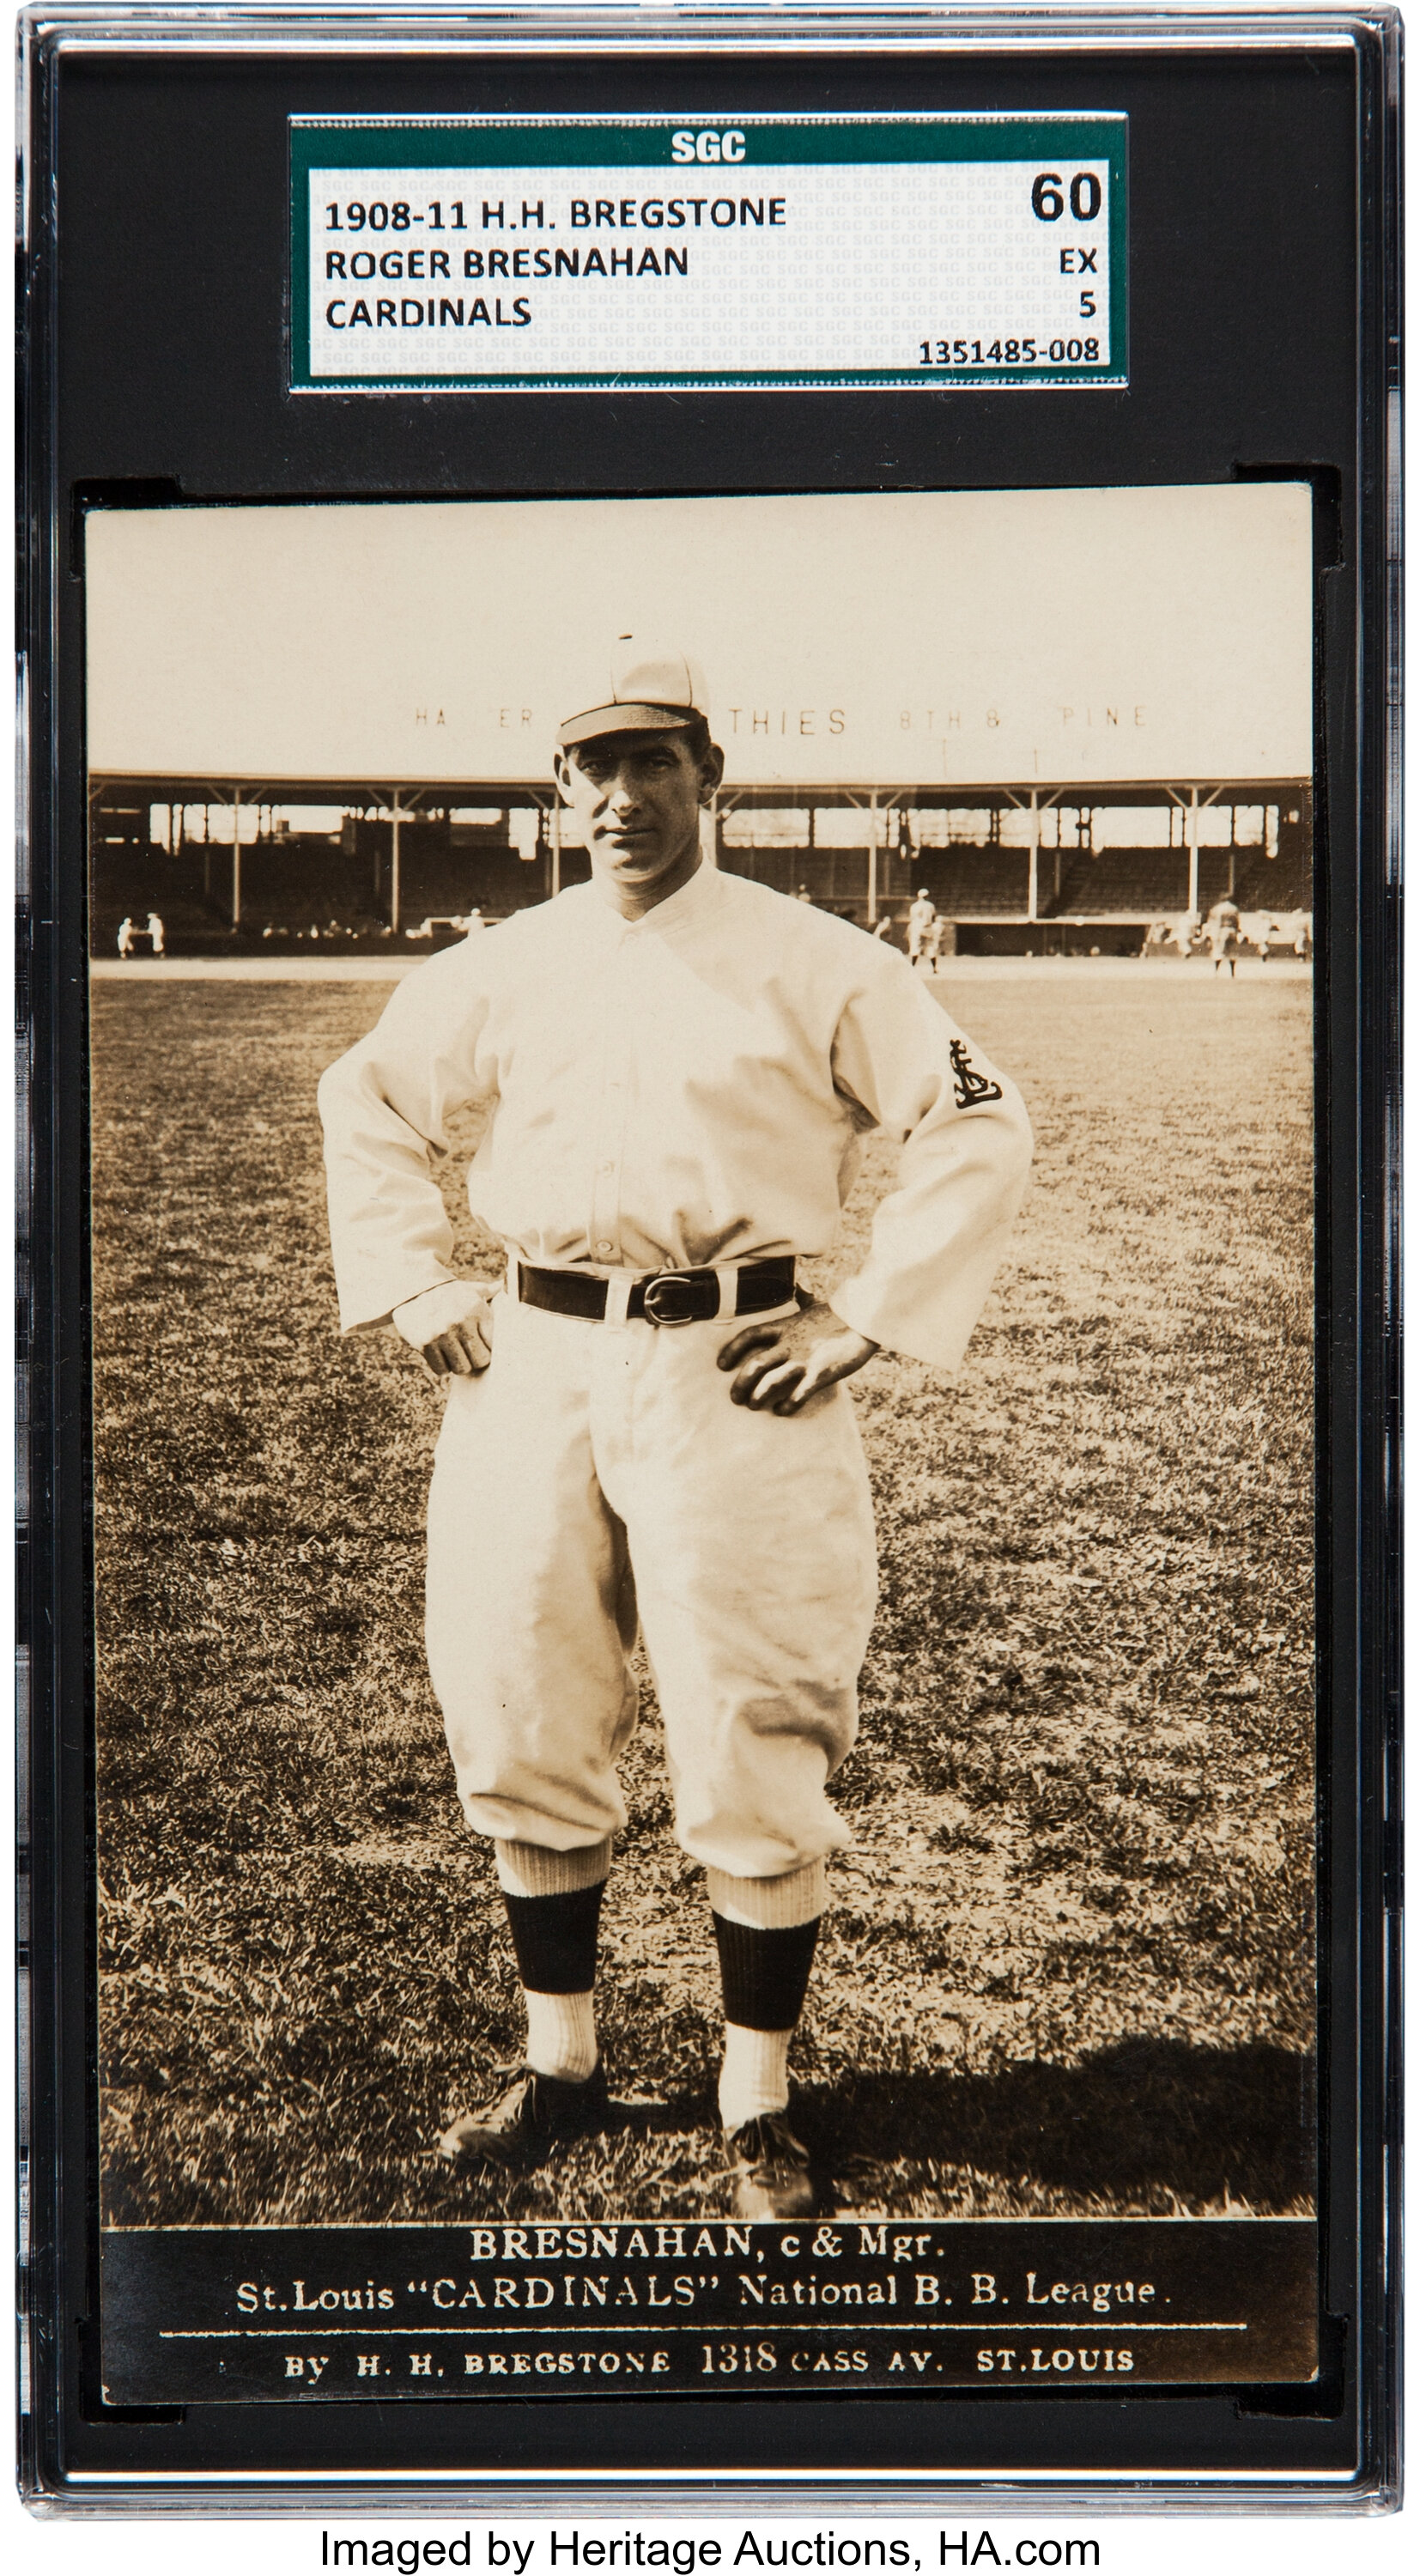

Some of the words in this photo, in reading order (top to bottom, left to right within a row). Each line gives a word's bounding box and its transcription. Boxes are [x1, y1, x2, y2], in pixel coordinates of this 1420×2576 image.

[672, 131, 746, 162] SGC
[323, 179, 353, 191] SGC
[361, 179, 391, 191] SGC
[398, 179, 429, 191] SGC
[475, 179, 505, 191] SGC
[513, 179, 543, 191] SGC
[550, 179, 581, 191] SGC
[588, 179, 619, 191] SGC
[626, 179, 657, 191] SGC
[664, 179, 695, 191] SGC
[701, 178, 732, 190] SGC
[739, 178, 770, 190] SGC
[777, 178, 808, 189] SGC
[816, 177, 846, 189] SGC
[853, 177, 883, 189] SGC
[891, 176, 922, 188] SGC
[929, 176, 960, 188] SGC
[967, 175, 998, 187] SGC
[794, 191, 824, 204] SGC
[832, 191, 862, 203] SGC
[870, 191, 901, 203] SGC
[907, 190, 938, 202] SGC
[945, 190, 976, 202] SGC
[983, 189, 1014, 201] SGC
[1031, 173, 1101, 222] 60
[326, 202, 468, 232] 1908-11
[482, 201, 555, 230] H.H.
[571, 197, 787, 228] BREGSTONE
[816, 205, 846, 217] SGC
[853, 205, 883, 217] SGC
[929, 204, 960, 216] SGC
[967, 204, 998, 216] SGC
[361, 237, 391, 249] SGC
[701, 235, 732, 247] SGC
[739, 235, 770, 246] SGC
[778, 234, 808, 246] SGC
[816, 234, 846, 246] SGC
[853, 234, 884, 246] SGC
[891, 234, 922, 245] SGC
[929, 233, 960, 245] SGC
[967, 233, 998, 244] SGC
[1004, 232, 1035, 244] SGC
[1043, 231, 1073, 243] SGC
[326, 250, 451, 280] ROGER
[464, 247, 688, 278] BRESNAHAN
[719, 249, 749, 261] SGC
[756, 249, 786, 261] SGC
[794, 249, 824, 260] SGC
[832, 248, 862, 260] SGC
[870, 248, 901, 259] SGC
[907, 247, 938, 259] SGC
[945, 247, 976, 258] SGC
[983, 246, 1014, 258] SGC
[1022, 246, 1052, 258] SGC
[1060, 248, 1097, 274] EX
[701, 264, 732, 276] SGC
[740, 264, 770, 276] SGC
[778, 264, 808, 275] SGC
[816, 263, 846, 275] SGC
[853, 263, 884, 274] SGC
[891, 262, 922, 274] SGC
[929, 262, 960, 273] SGC
[967, 261, 998, 273] SGC
[1004, 260, 1035, 272] SGC
[681, 278, 711, 290] SGC
[719, 278, 749, 289] SGC
[756, 277, 786, 289] SGC
[794, 277, 824, 289] SGC
[832, 276, 863, 289] SGC
[870, 276, 901, 289] SGC
[907, 276, 938, 288] SGC
[945, 276, 976, 287] SGC
[983, 275, 1014, 287] SGC
[1022, 275, 1052, 286] SGC
[550, 294, 581, 305] SGC
[588, 293, 619, 305] SGC
[626, 293, 657, 305] SGC
[664, 293, 695, 305] SGC
[702, 293, 732, 304] SGC
[740, 292, 770, 304] SGC
[778, 292, 808, 304] SGC
[816, 291, 846, 303] SGC
[853, 291, 884, 303] SGC
[891, 290, 922, 302] SGC
[929, 290, 960, 302] SGC
[967, 289, 998, 301] SGC
[1004, 289, 1035, 301] SGC
[1043, 289, 1073, 301] SGC
[1079, 291, 1096, 318] 5
[325, 297, 531, 329] CARDINALS
[550, 322, 581, 334] SGC
[588, 322, 619, 333] SGC
[626, 321, 657, 333] SGC
[664, 321, 695, 333] SGC
[702, 321, 732, 332] SGC
[740, 320, 770, 332] SGC
[778, 320, 808, 332] SGC
[816, 320, 846, 331] SGC
[853, 319, 884, 331] SGC
[891, 319, 922, 331] SGC
[929, 319, 960, 331] SGC
[967, 319, 998, 330] SGC
[1005, 318, 1035, 330] SGC
[1043, 317, 1073, 329] SGC
[323, 352, 354, 364] SGC
[361, 352, 391, 363] SGC
[399, 351, 430, 363] SGC
[437, 351, 468, 363] SGC
[475, 351, 506, 363] SGC
[513, 351, 543, 362] SGC
[550, 350, 581, 362] SGC
[588, 350, 619, 362] SGC
[626, 350, 657, 361] SGC
[664, 349, 695, 361] SGC
[702, 349, 732, 361] SGC
[740, 349, 770, 361] SGC
[778, 349, 808, 361] SGC
[816, 349, 847, 361] SGC
[853, 348, 884, 360] SGC
[919, 338, 1100, 365] 1351485-008
[728, 708, 846, 735] THIES
[1059, 706, 1147, 727] PINE
[470, 2226, 765, 2263] BRESNAHAN,
[780, 2235, 800, 2257] c
[811, 2226, 842, 2257] &
[859, 2225, 944, 2263] Mgr.
[236, 2280, 394, 2313] St.Louis
[738, 2275, 897, 2306] National
[914, 2274, 952, 2306] B.
[971, 2273, 1009, 2305] B.
[1026, 2272, 1170, 2312] League.
[356, 2354, 391, 2378] H.
[464, 2351, 671, 2375] BREGSTONE
[701, 2342, 777, 2374] 1318
[791, 2350, 869, 2372] CASS
[888, 2351, 944, 2372] AV.
[977, 2348, 1134, 2372] ST.LOUIS
